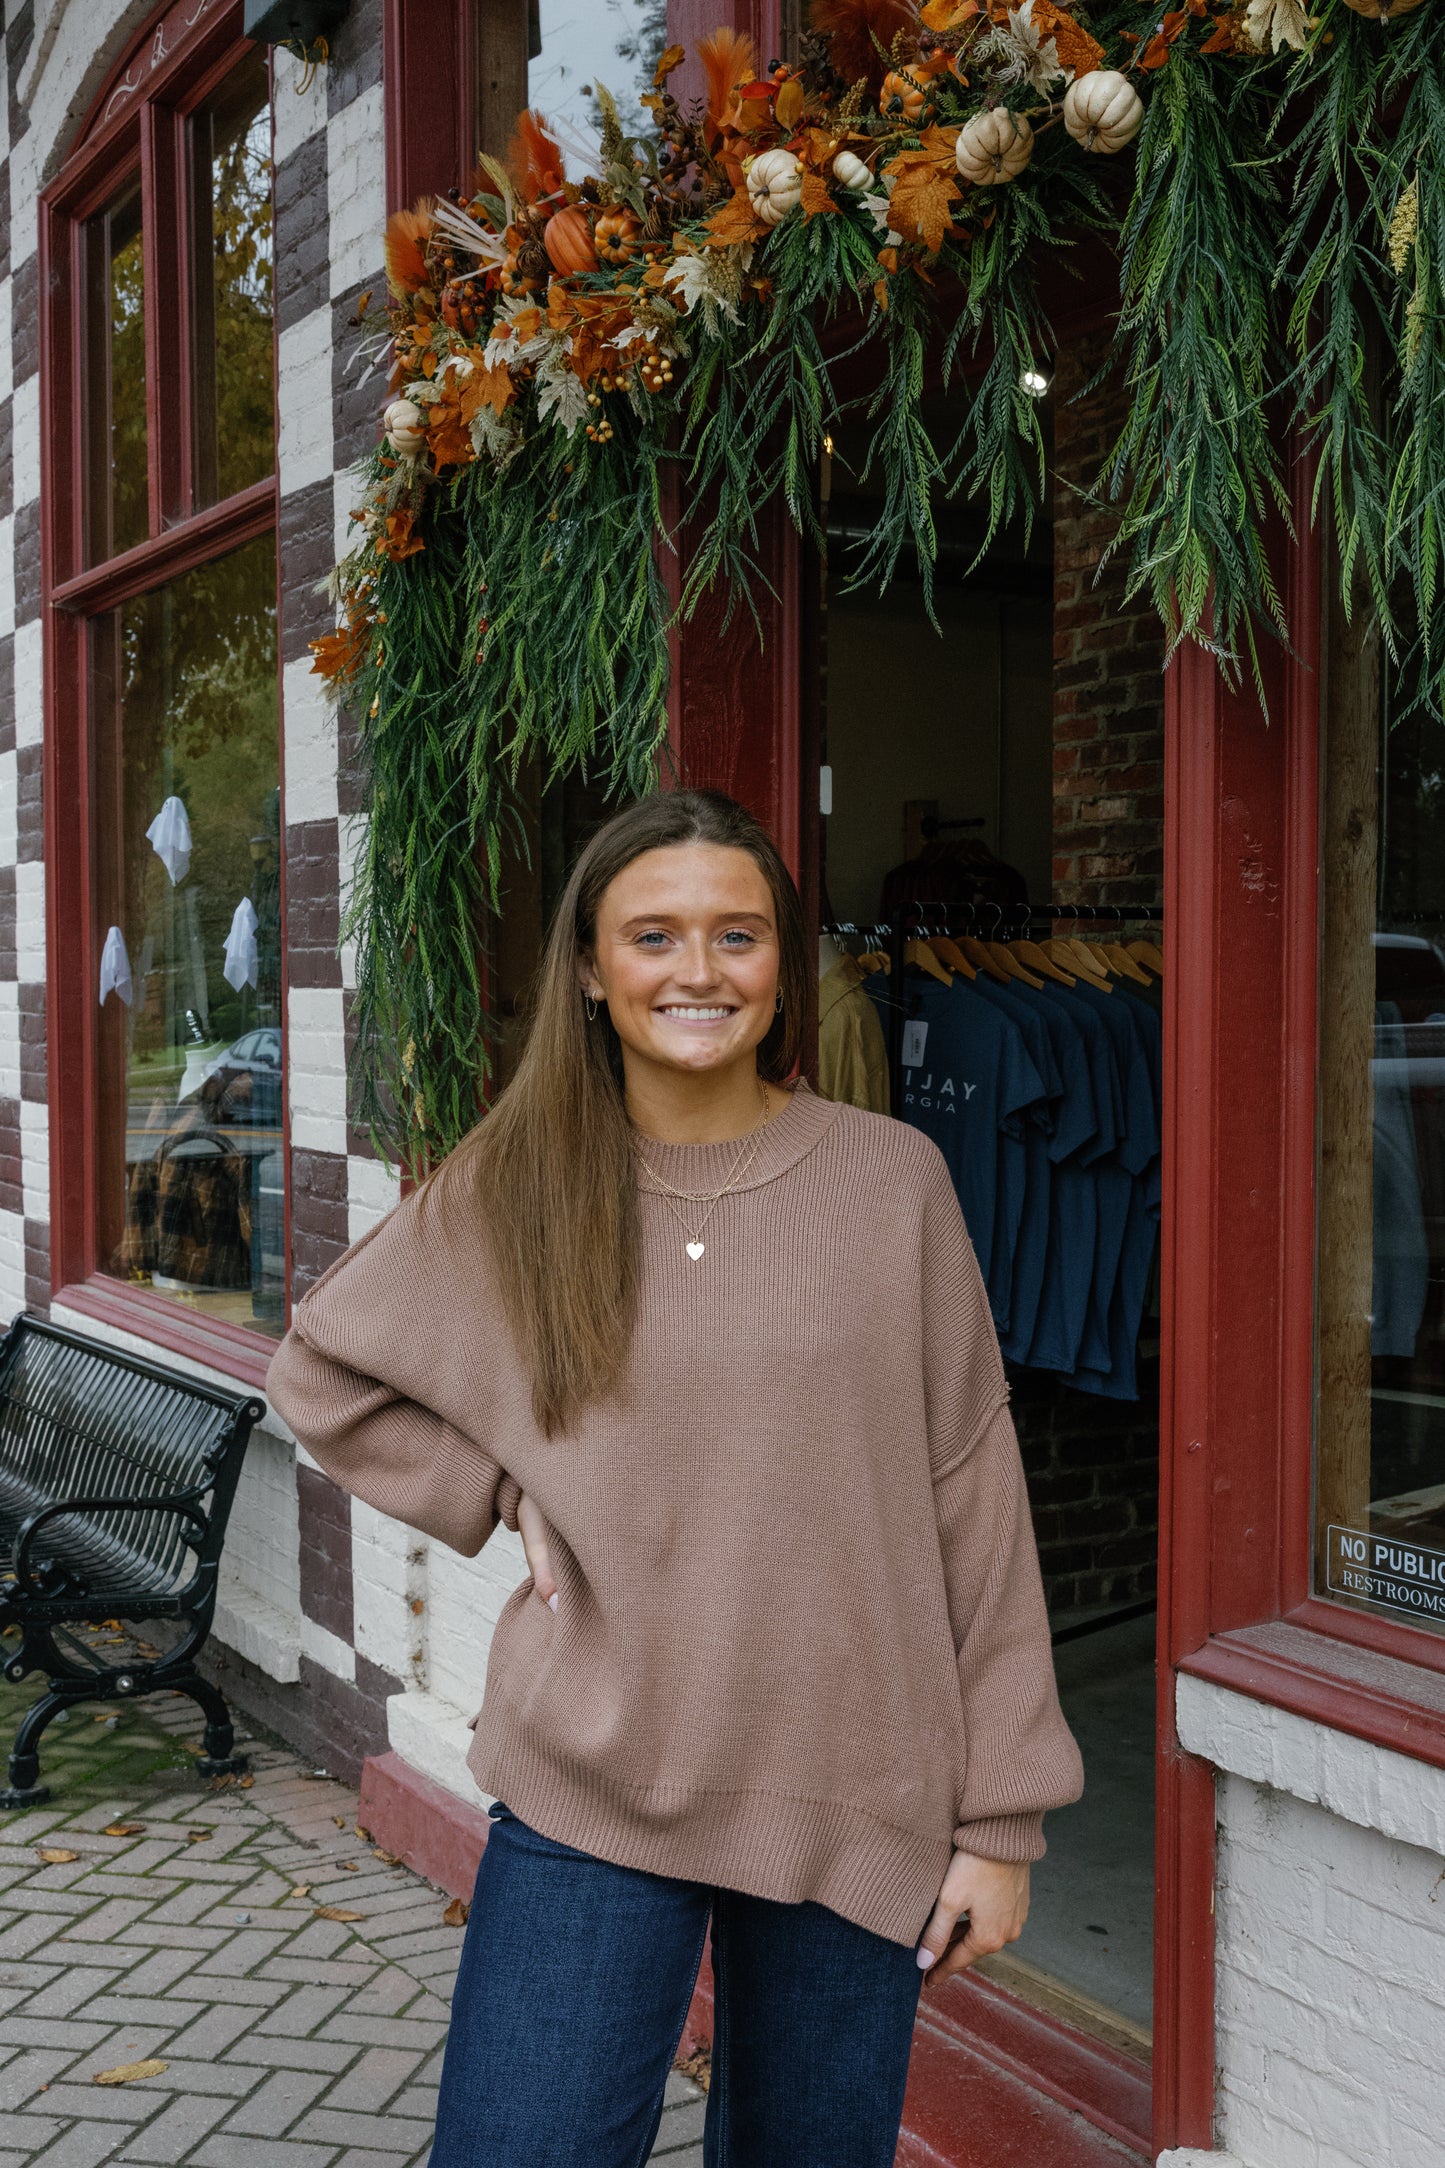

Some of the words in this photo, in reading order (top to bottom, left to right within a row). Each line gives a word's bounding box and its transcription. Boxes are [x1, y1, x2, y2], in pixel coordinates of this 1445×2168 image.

[1340, 1535, 1366, 1562] NO
[1375, 1544, 1445, 1584] PUBLIC
[1342, 1569, 1445, 1614] RESTROOMS
